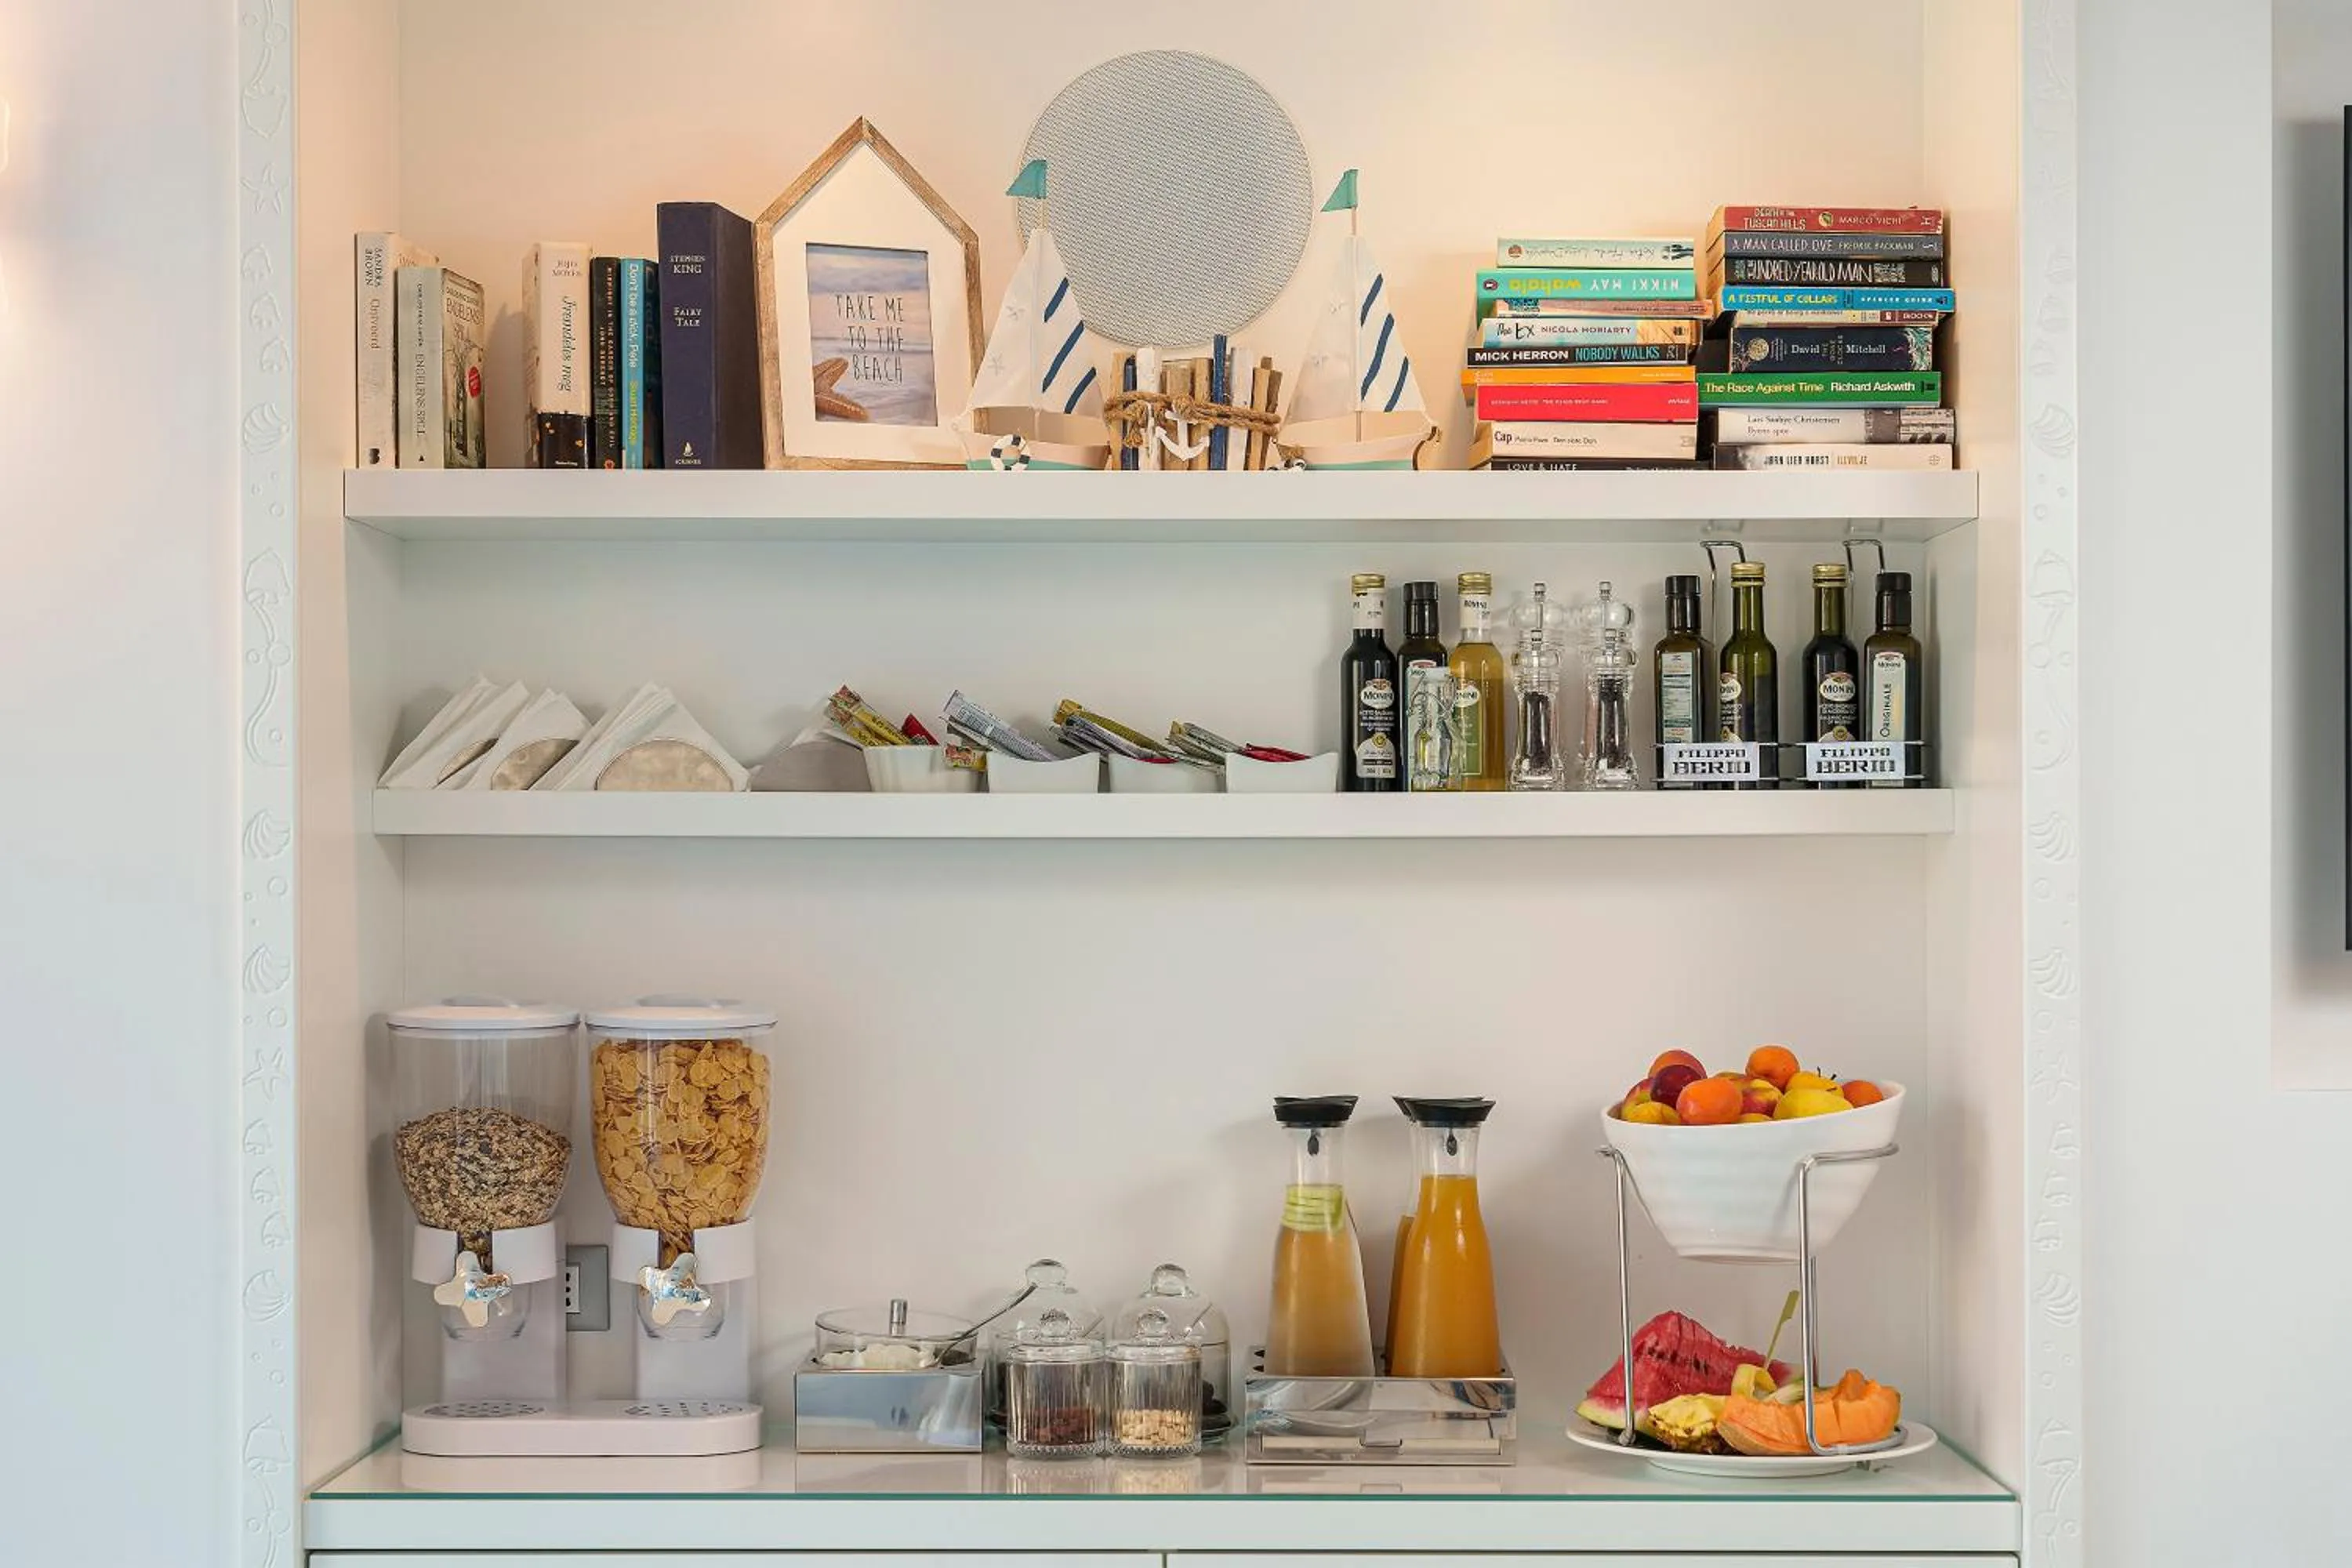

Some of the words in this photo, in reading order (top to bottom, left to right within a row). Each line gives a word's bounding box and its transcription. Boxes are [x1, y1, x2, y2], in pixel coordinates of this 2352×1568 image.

[1780, 217, 1806, 230] HILLS
[1839, 216, 1873, 225] MARCO
[1876, 216, 1903, 225] VICHI
[1732, 238, 1740, 250] A
[1743, 238, 1766, 250] MAN
[1771, 238, 1808, 251] CALLED
[1812, 239, 1833, 251] OVE
[365, 248, 374, 286] BROWN
[375, 248, 383, 288] SANDRA
[673, 264, 702, 274] KING
[1836, 262, 1872, 282] MAN
[630, 263, 639, 291] Don't
[1508, 278, 1581, 295] wahala
[1590, 279, 1621, 291] MAY
[1632, 279, 1679, 290] NIKKI
[630, 293, 638, 306] be
[1728, 294, 1737, 303] A
[1739, 294, 1782, 303] FISTFUL
[1784, 294, 1795, 303] OF
[673, 307, 702, 316] FAIRY
[835, 294, 876, 321] TAKE
[885, 296, 904, 322] ME
[676, 317, 701, 327] TALE
[1496, 322, 1512, 337] The
[1541, 325, 1578, 334] NICOLA
[1582, 326, 1632, 335] MORIARTY
[848, 325, 866, 350] TO
[876, 326, 904, 352] THE
[630, 344, 639, 368] Pete
[1475, 350, 1509, 362] MICK
[1512, 350, 1569, 361] HERRON
[1575, 347, 1618, 361] NOBODY
[1621, 346, 1660, 361] WALKS
[1791, 344, 1820, 354] David
[1846, 344, 1886, 354] Mitchell
[852, 354, 903, 383] BEACH
[557, 365, 572, 392] meg
[1706, 383, 1724, 392] The
[1727, 383, 1754, 392] Race
[1755, 382, 1795, 394] Against
[1798, 382, 1824, 391] Time
[1831, 382, 1871, 391] Richard
[1873, 382, 1915, 391] Askwith
[1494, 431, 1512, 445] Cap
[1880, 684, 1891, 737] ORIGINALE
[1679, 750, 1746, 758] FILIPPO
[1820, 748, 1890, 757] FILIPPO
[1672, 761, 1751, 775] BERIO
[1816, 760, 1896, 774] BERIO
